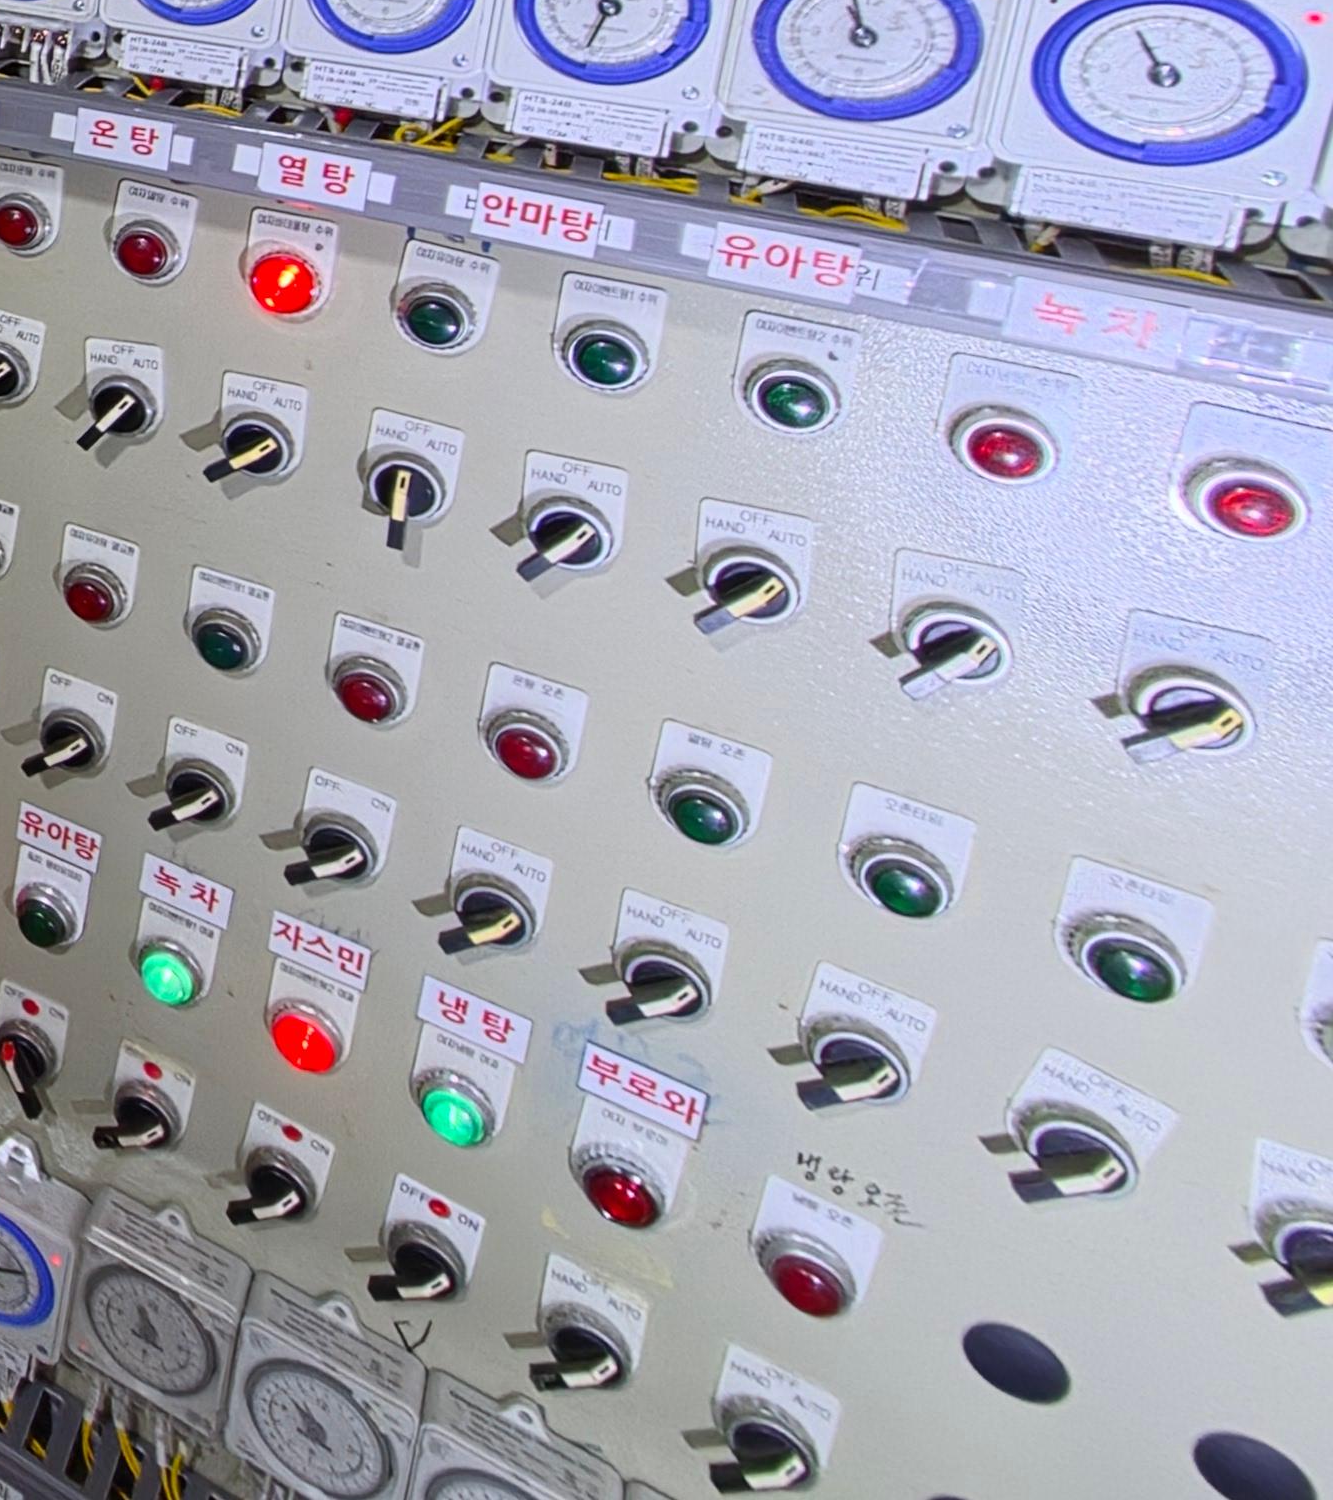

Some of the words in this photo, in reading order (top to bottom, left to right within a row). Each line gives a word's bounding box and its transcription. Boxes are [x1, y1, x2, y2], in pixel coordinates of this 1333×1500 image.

[482, 194, 598, 243] 안마탕
[718, 234, 860, 287] 유아탕
[0, 314, 22, 328] OFF
[16, 331, 41, 346] AUTO
[112, 344, 136, 356] OFF
[90, 352, 119, 367] HAND
[133, 358, 159, 371] AUTO
[227, 387, 258, 403] HAND
[273, 397, 303, 412] AUTO
[252, 381, 278, 395] OFF
[376, 424, 410, 443] HAND
[426, 439, 458, 456] AUTO
[405, 420, 432, 436] OFF
[530, 467, 568, 486] HAND
[588, 480, 623, 497] AUTO
[562, 462, 592, 477] OFF
[704, 516, 746, 535] HAND
[768, 528, 808, 548] AUTO
[739, 509, 774, 527] OFF
[50, 674, 71, 688] OFF
[97, 691, 114, 706] ON
[174, 723, 197, 738] OFF
[225, 742, 244, 757] ON
[314, 775, 341, 791] OFF
[371, 798, 391, 814] ON
[20, 810, 99, 861] 유아탕
[491, 841, 520, 859] OFF
[460, 842, 495, 863] HAND
[514, 862, 547, 883] AUTO
[626, 906, 665, 928] HAND
[685, 928, 723, 950] AUTO
[659, 905, 693, 925] OFF
[273, 919, 365, 979] 자스민
[818, 980, 863, 1007] HAND
[886, 1006, 927, 1032] AUTO
[857, 981, 894, 1003] OFF
[585, 1054, 700, 1126] 부로와
[399, 1182, 428, 1204] OFF
[458, 1213, 480, 1233] ON
